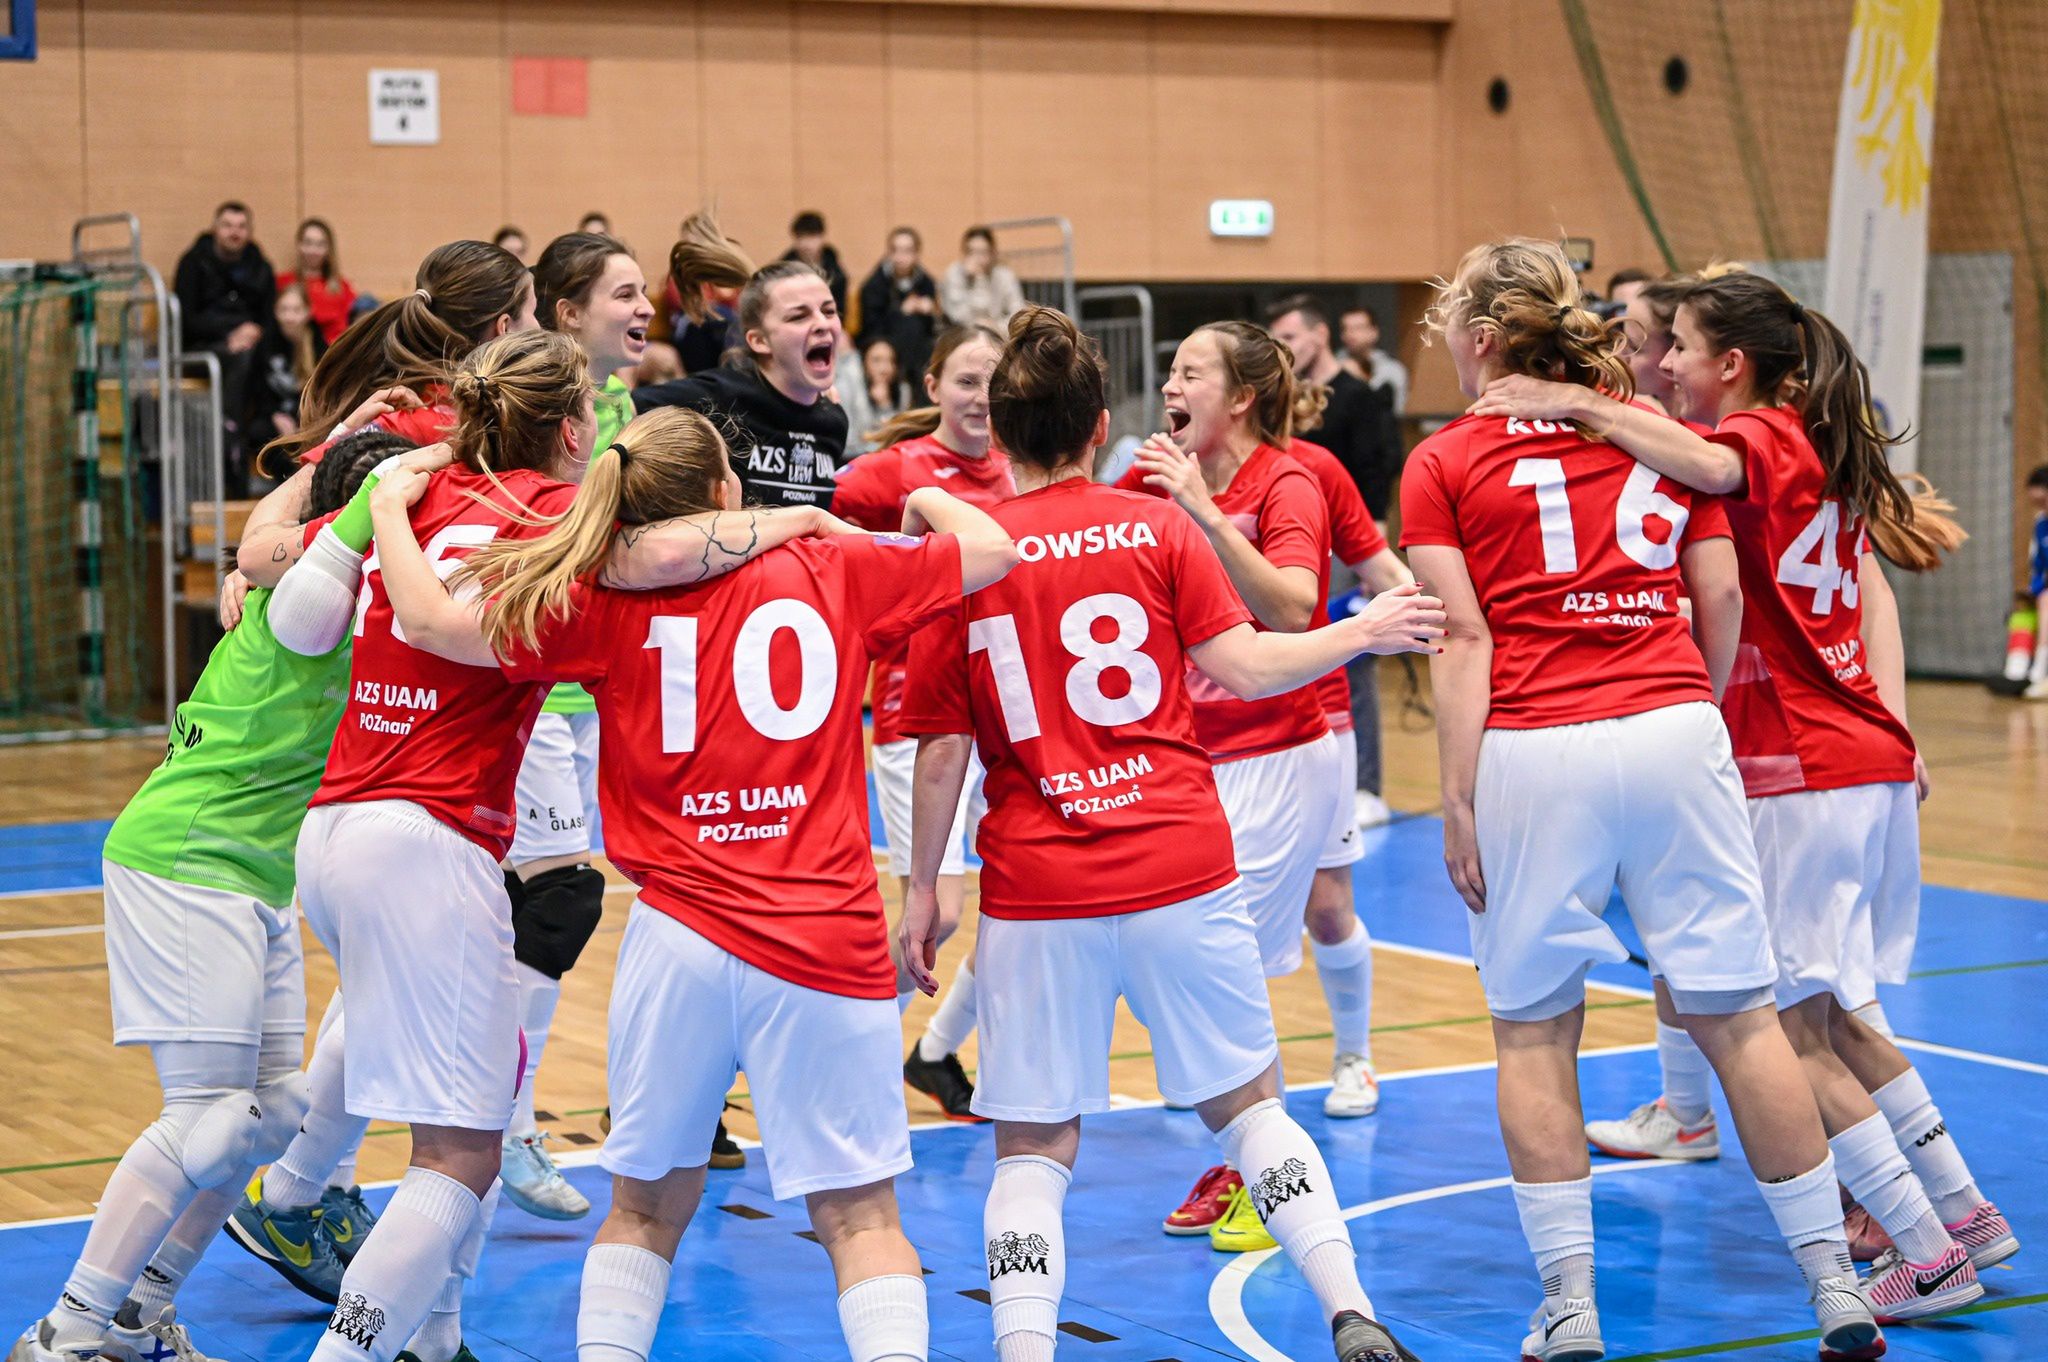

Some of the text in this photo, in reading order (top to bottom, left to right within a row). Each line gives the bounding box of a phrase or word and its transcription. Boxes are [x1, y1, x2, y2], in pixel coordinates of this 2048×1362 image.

[747, 444, 786, 474] AZS
[1507, 458, 1690, 574] 16
[1012, 521, 1158, 563] OWSKA
[1561, 591, 1610, 613] AZS
[641, 597, 838, 754] 10
[968, 592, 1163, 744] 18
[354, 680, 438, 711] AZS UAM
[1039, 753, 1154, 798] AZS UAM
[680, 784, 808, 817] AZS UAM
[1257, 1177, 1314, 1226] UAM
[989, 1254, 1050, 1281] UAM
[328, 1313, 376, 1353] UAM
